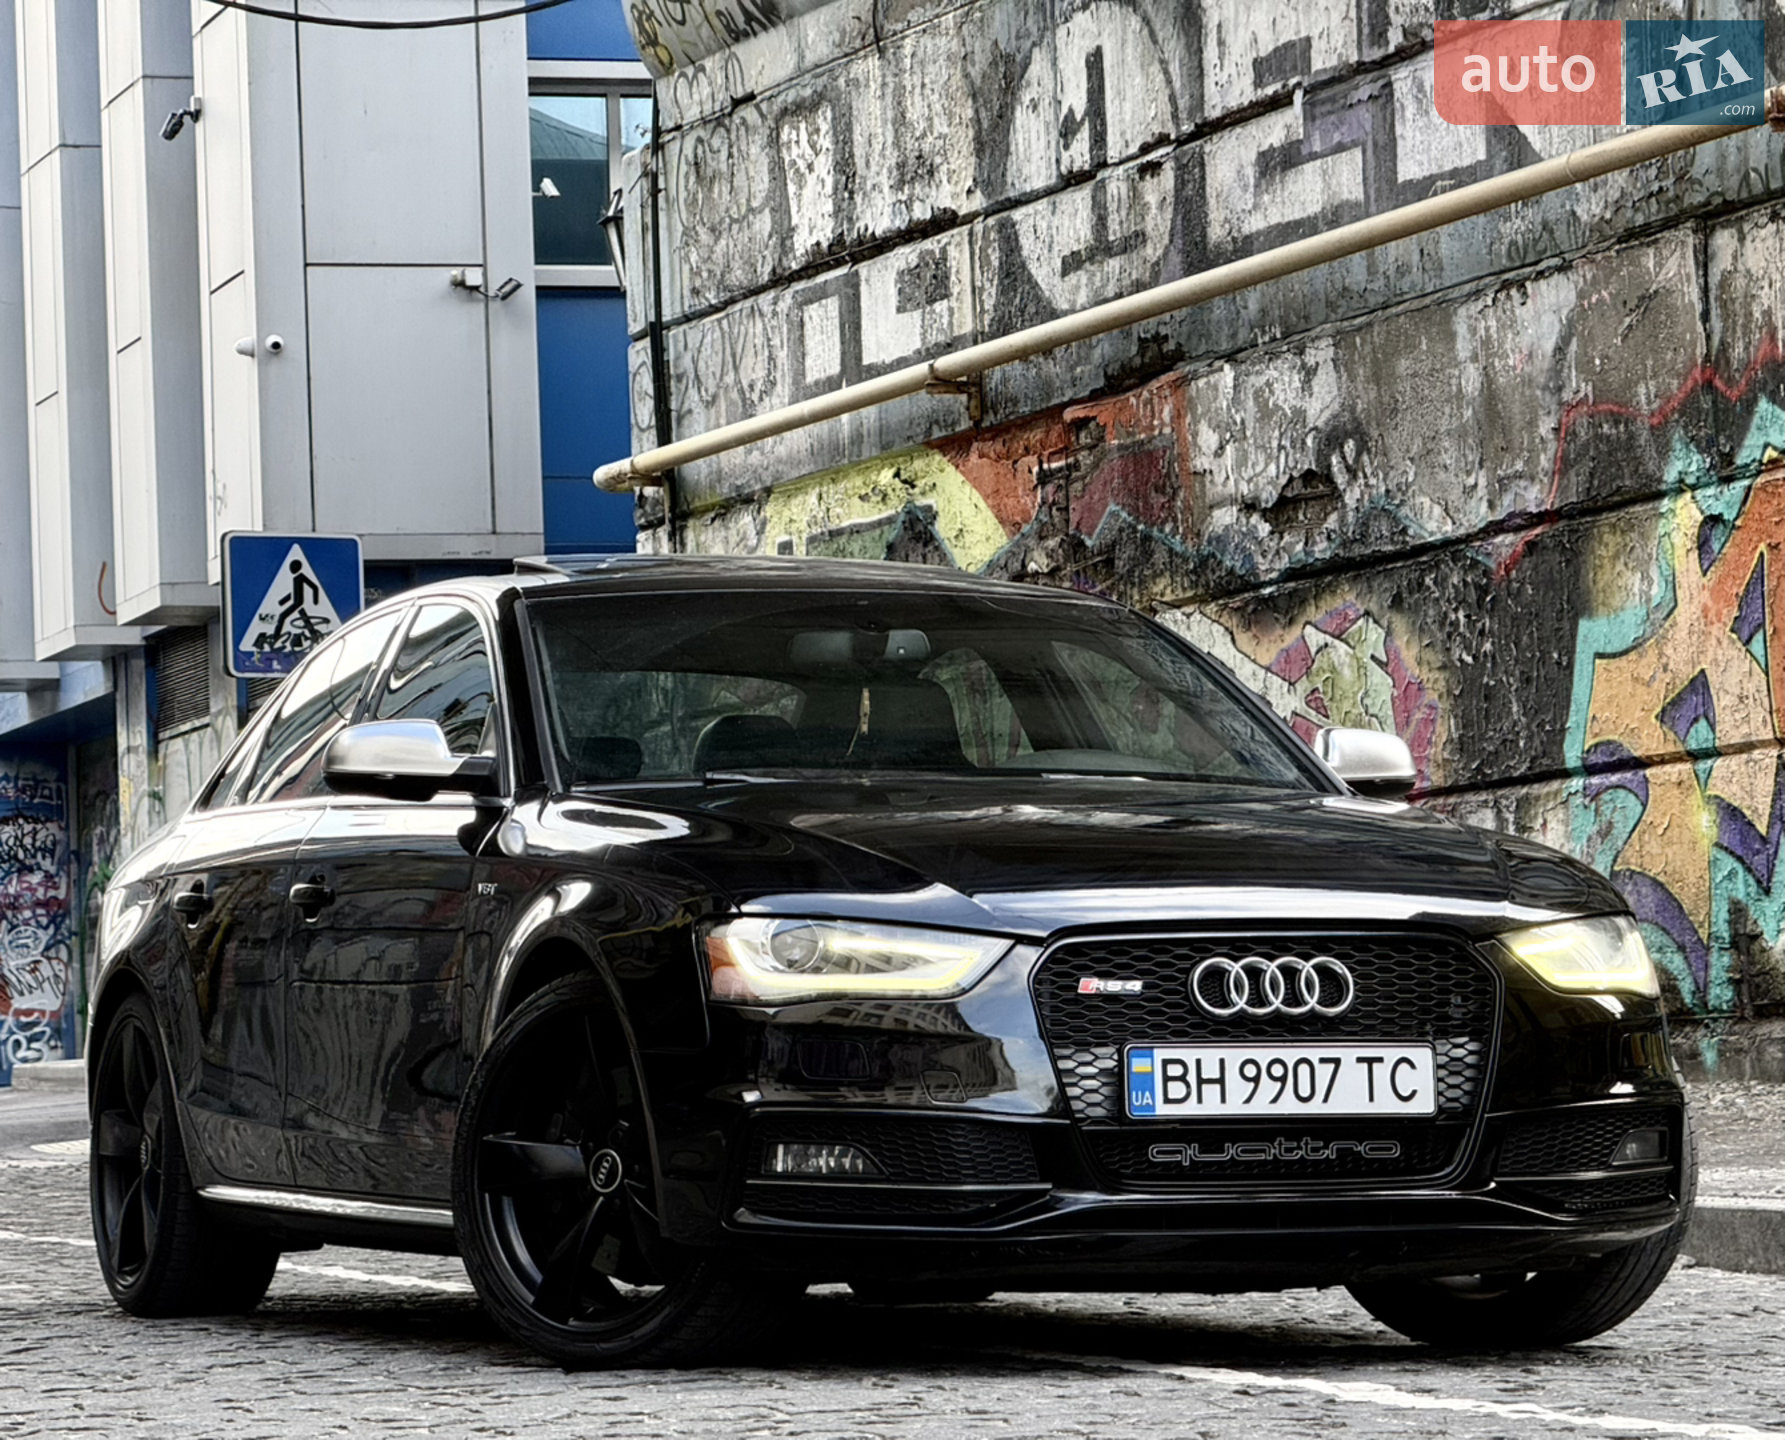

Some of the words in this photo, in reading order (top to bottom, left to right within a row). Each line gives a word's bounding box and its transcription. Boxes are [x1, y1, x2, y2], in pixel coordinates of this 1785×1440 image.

[1086, 979, 1143, 994] RS4
[1161, 1057, 1227, 1105] BH
[1238, 1056, 1342, 1105] 9907
[1355, 1055, 1418, 1103] TC
[1131, 1090, 1153, 1107] UA
[1149, 1136, 1400, 1167] quattro
